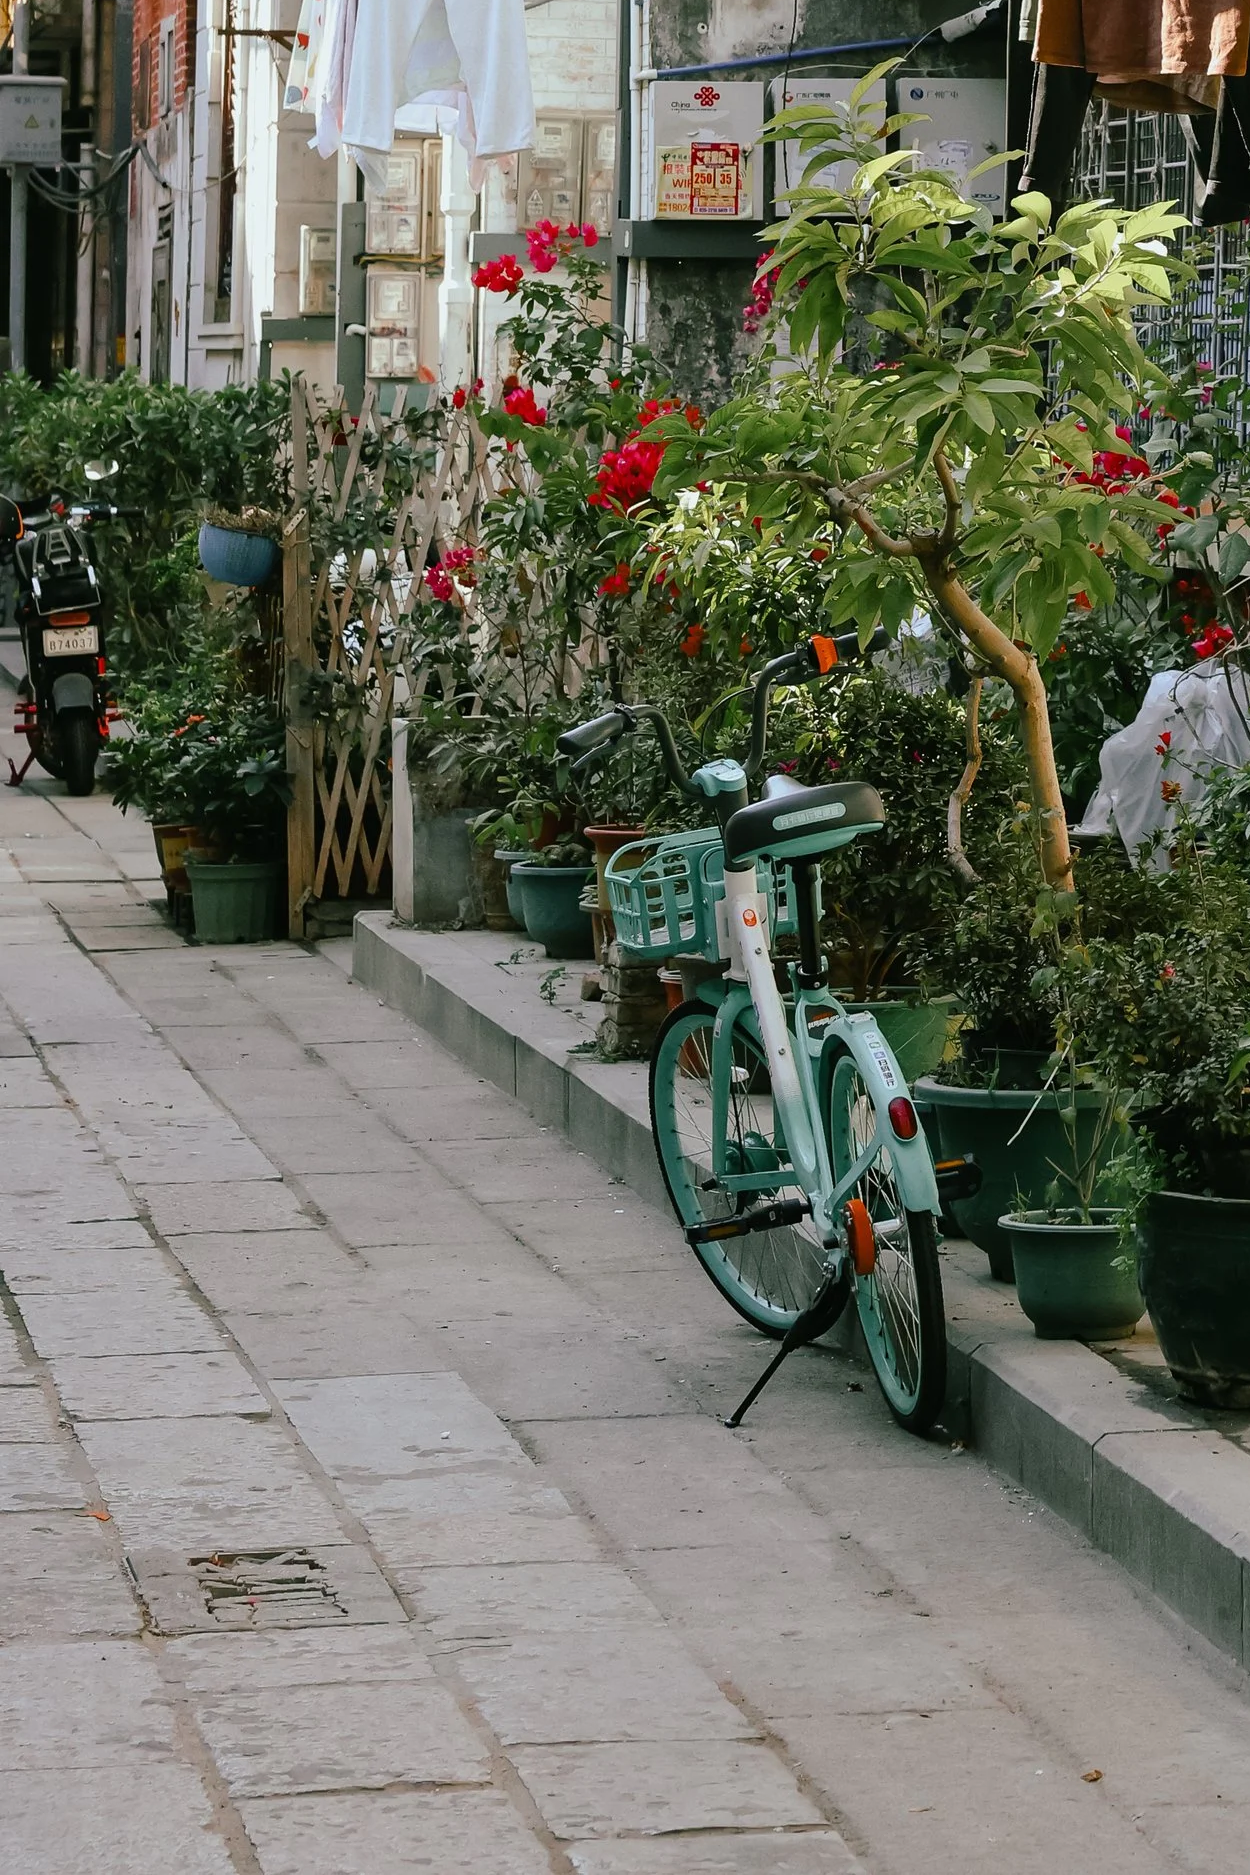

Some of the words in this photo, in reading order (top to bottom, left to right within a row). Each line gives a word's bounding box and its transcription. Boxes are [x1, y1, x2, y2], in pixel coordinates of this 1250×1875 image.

[694, 173, 712, 184] 250
[720, 173, 732, 184] 35
[50, 638, 93, 651] B74037
